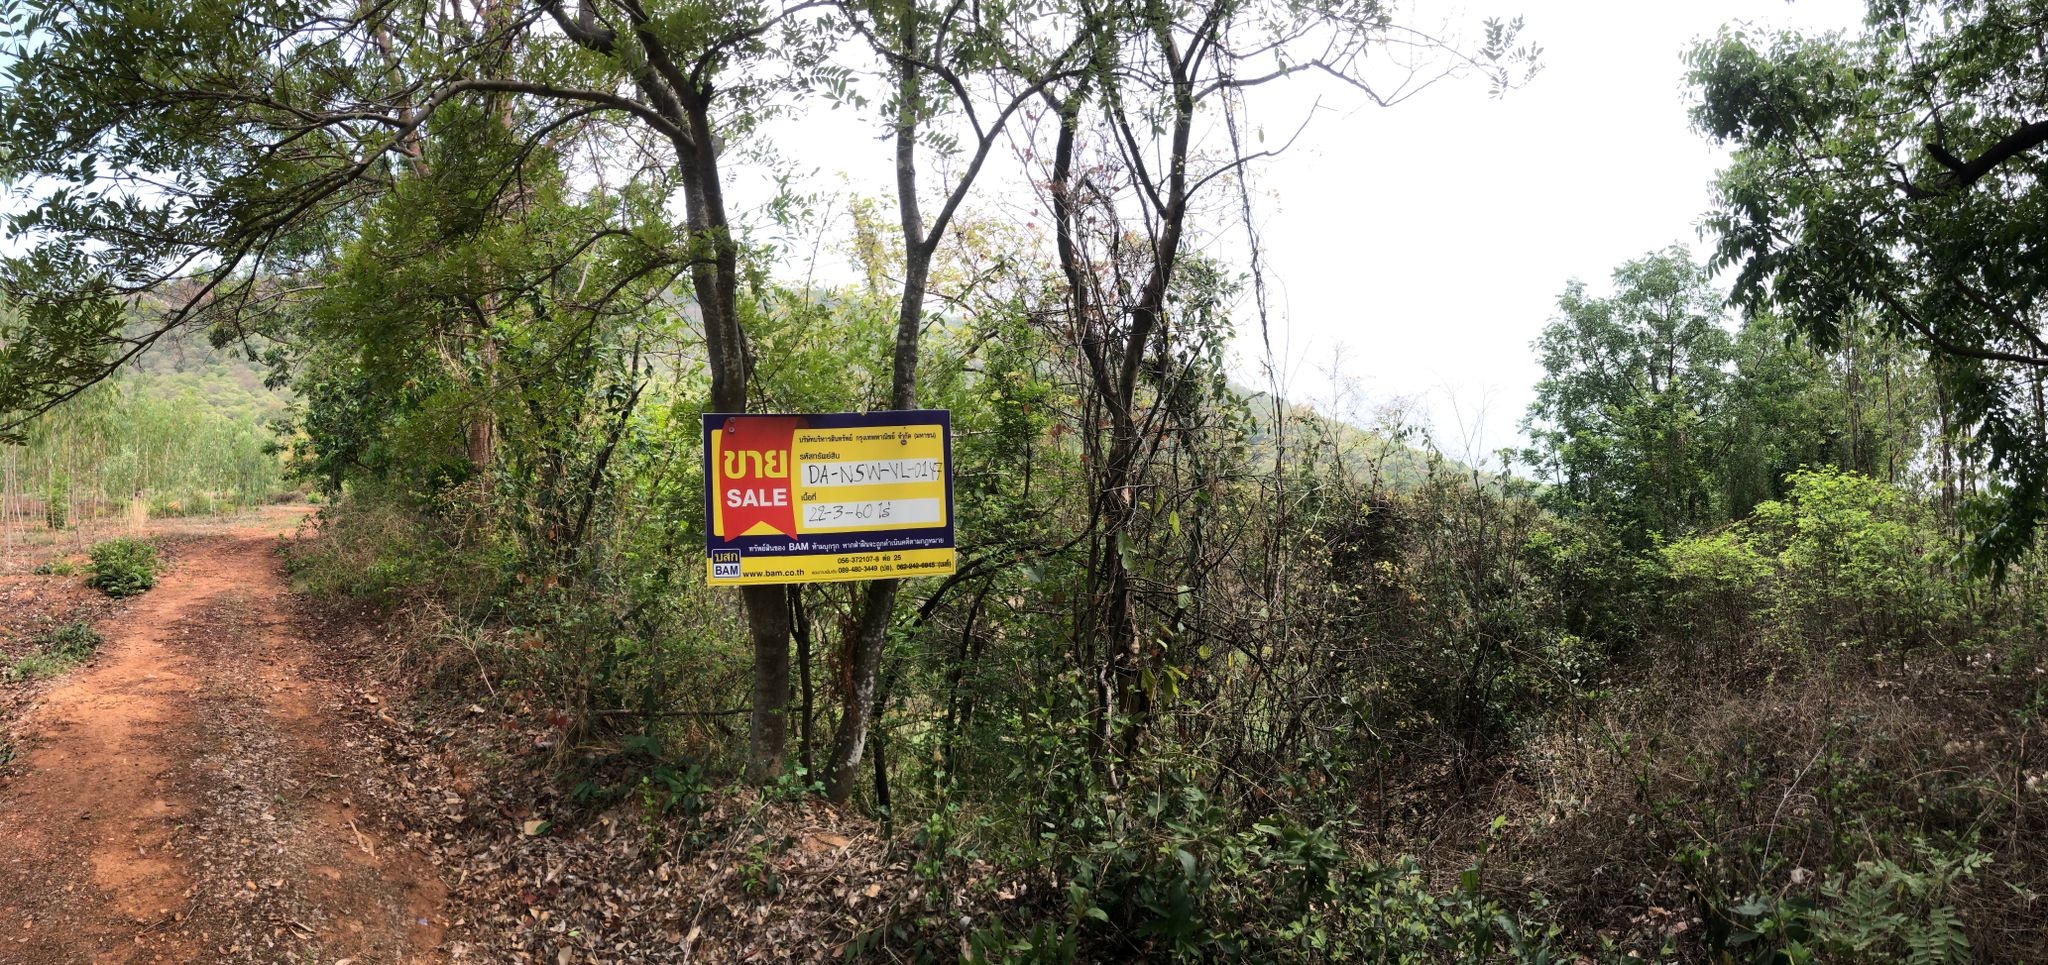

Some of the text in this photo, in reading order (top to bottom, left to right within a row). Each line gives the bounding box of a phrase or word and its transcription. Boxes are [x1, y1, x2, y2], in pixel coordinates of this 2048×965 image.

[914, 431, 937, 441] (มหาชน)
[724, 449, 788, 480] ขาย
[726, 488, 788, 508] SALE
[809, 503, 873, 522] 22-3-60
[788, 542, 809, 551] BAM
[715, 552, 738, 563] บสก
[715, 565, 738, 576] BAM
[743, 569, 805, 577] www.bam.co.th
